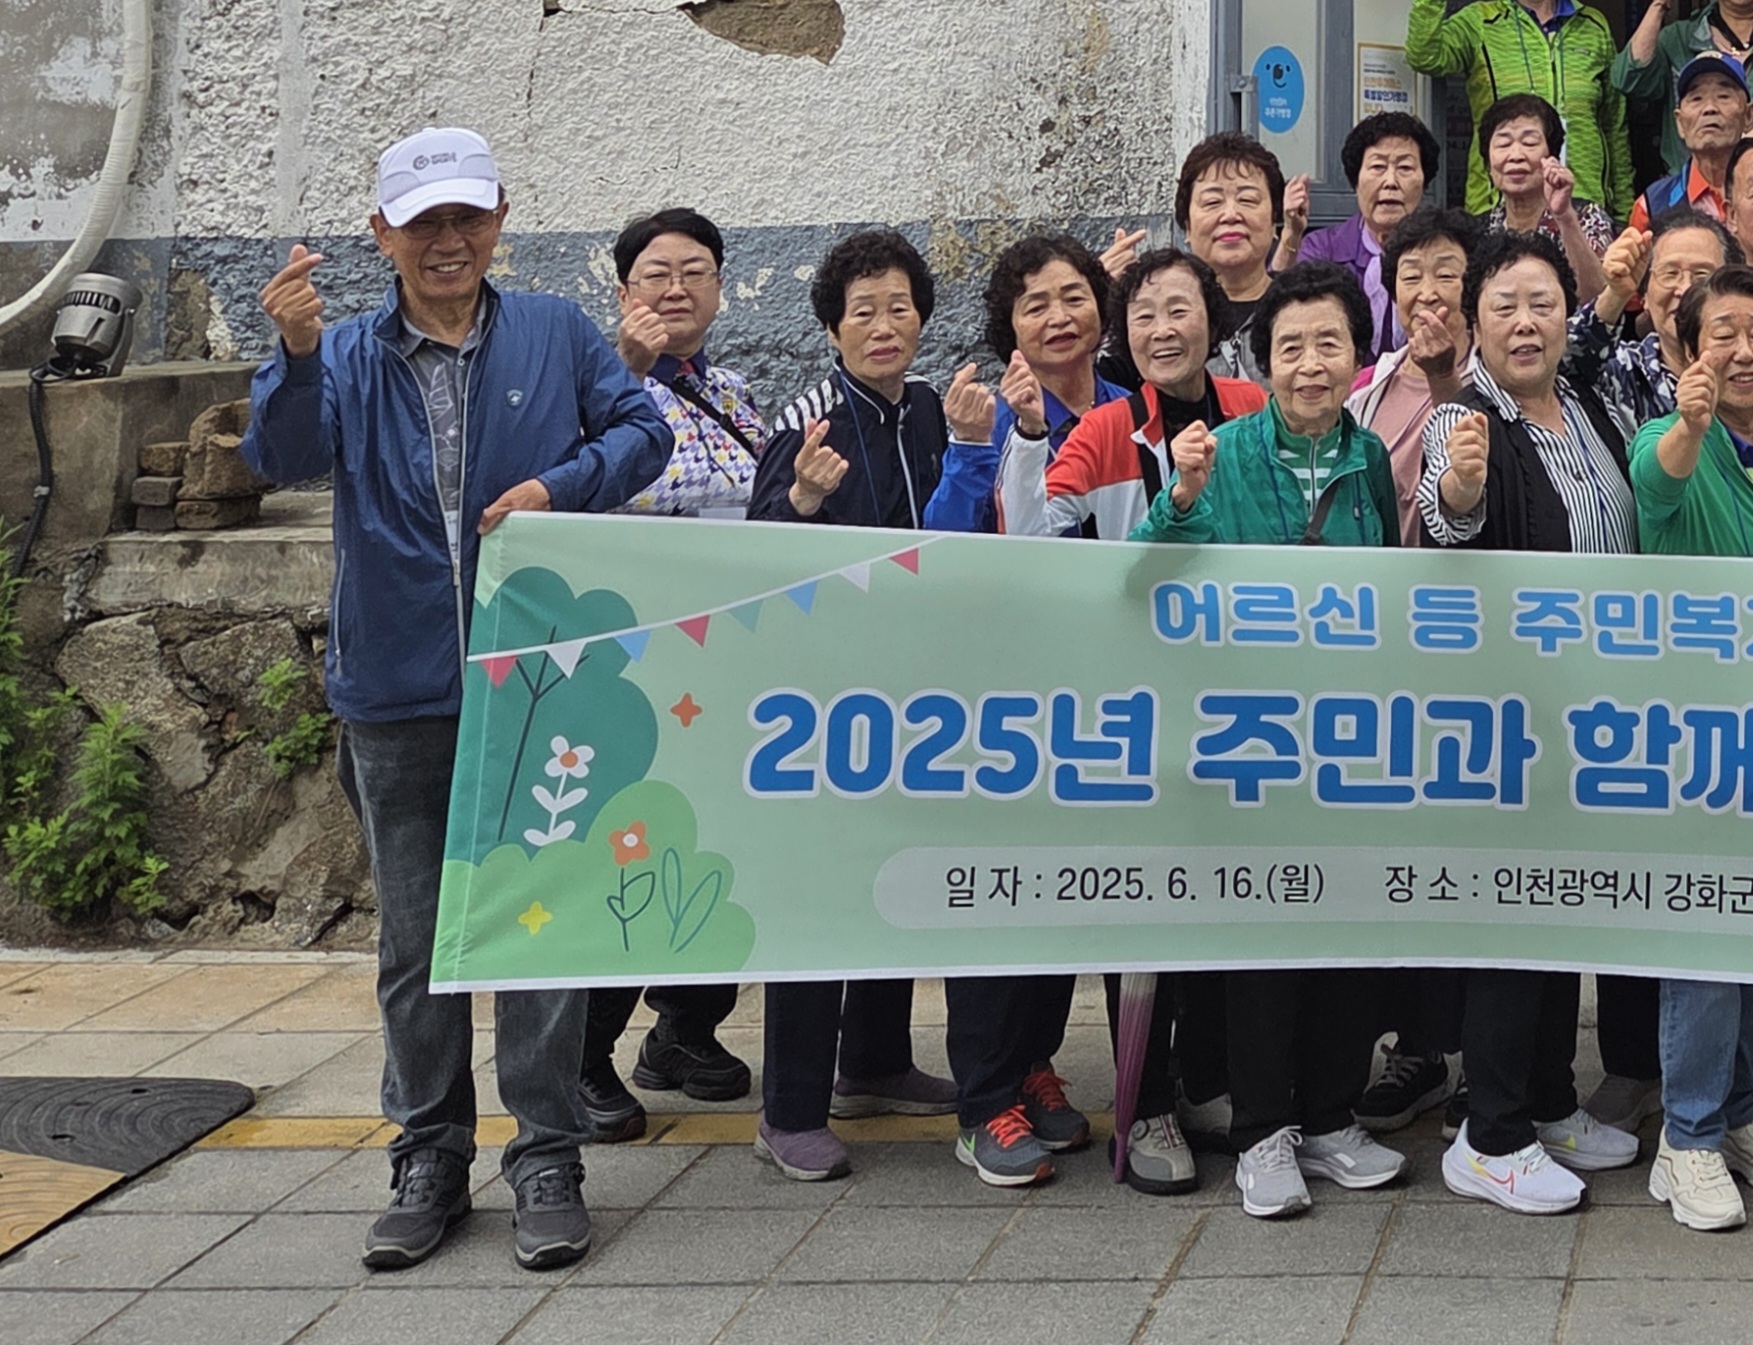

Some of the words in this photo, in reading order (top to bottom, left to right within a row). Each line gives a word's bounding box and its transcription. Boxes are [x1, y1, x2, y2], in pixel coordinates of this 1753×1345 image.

[1152, 581, 1379, 650] 어르신
[1410, 584, 1482, 653] 등
[745, 686, 1159, 807] 2025년
[1188, 691, 1541, 809] 주민과
[1056, 867, 1154, 902] 2025.
[1167, 866, 1198, 901] 6.
[1214, 863, 1325, 904] 16.(월)
[1494, 867, 1651, 911] 인천광역시
